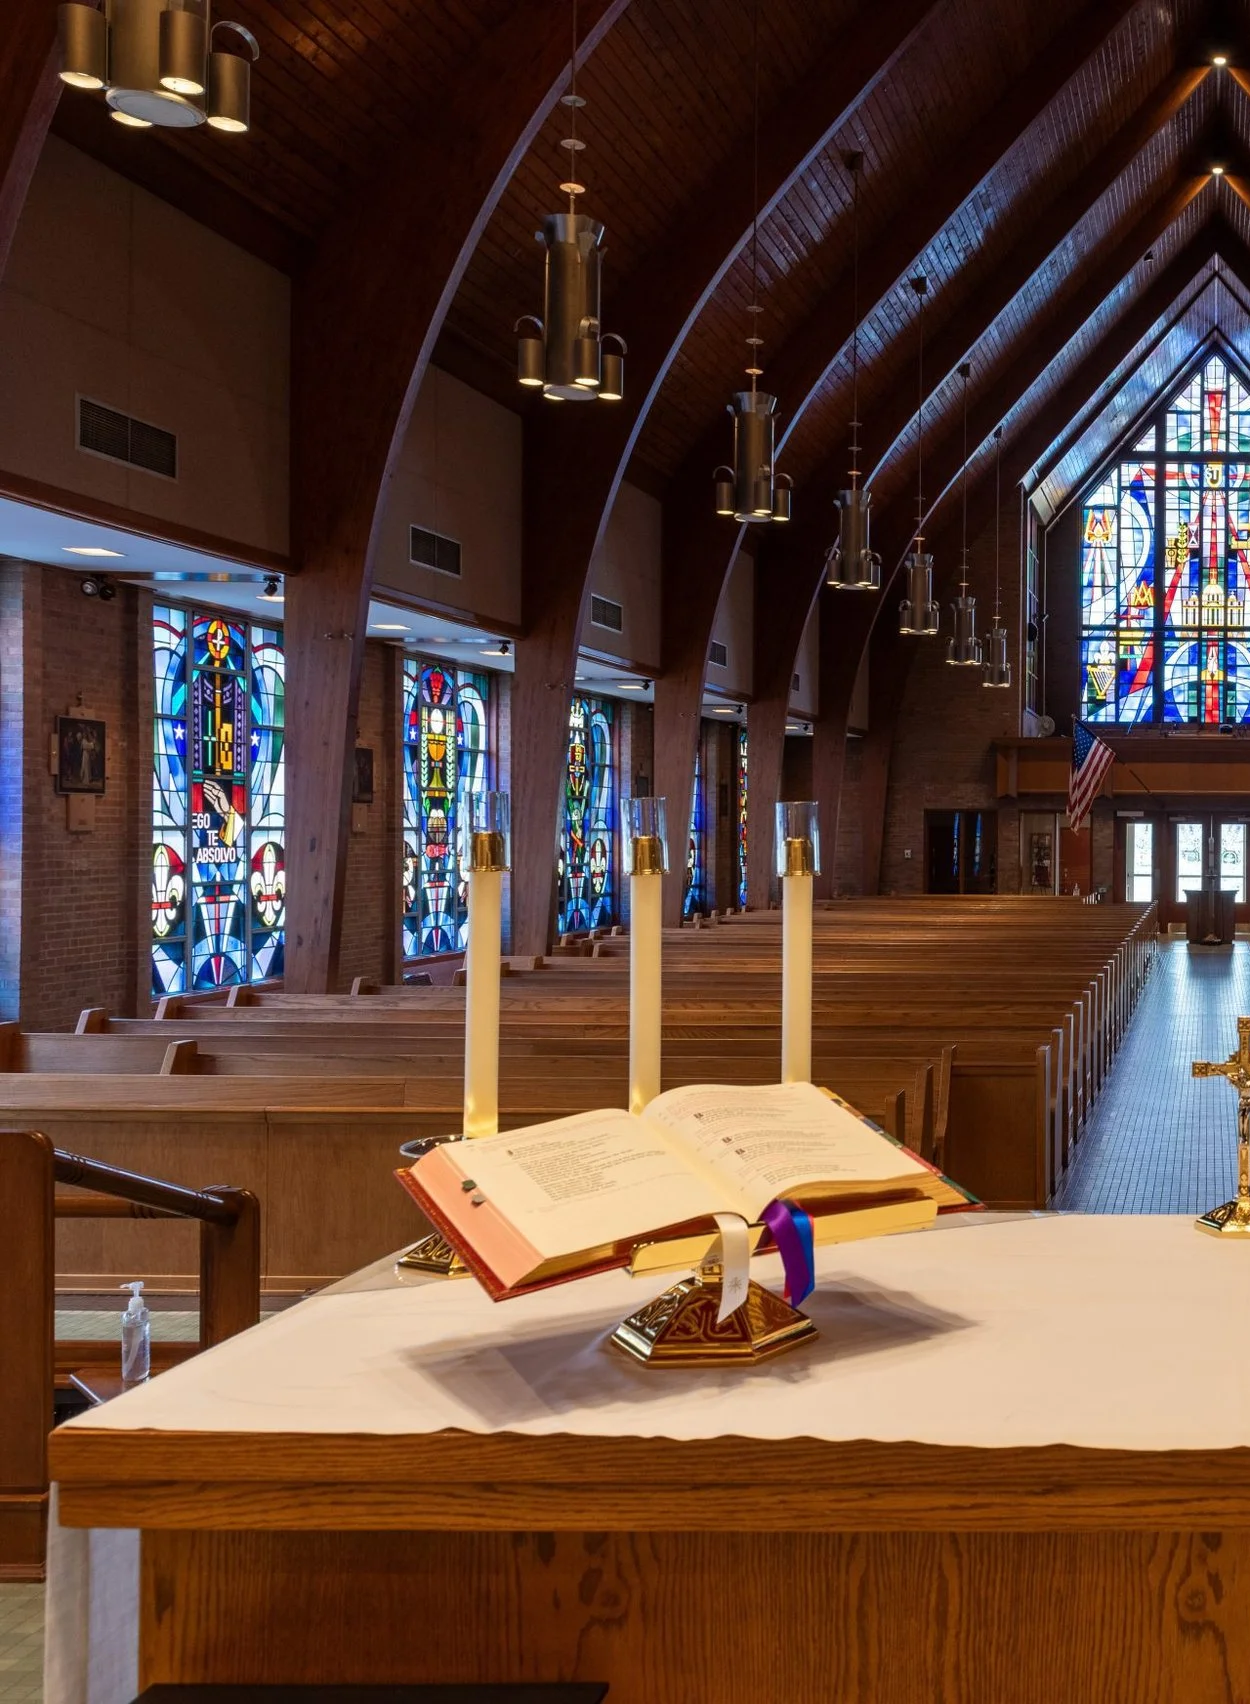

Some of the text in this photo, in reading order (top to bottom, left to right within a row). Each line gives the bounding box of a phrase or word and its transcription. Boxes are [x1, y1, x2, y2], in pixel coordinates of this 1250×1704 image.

[192, 813, 210, 829] EGO
[206, 830, 219, 846] TE
[196, 847, 236, 863] ABSOLVO
